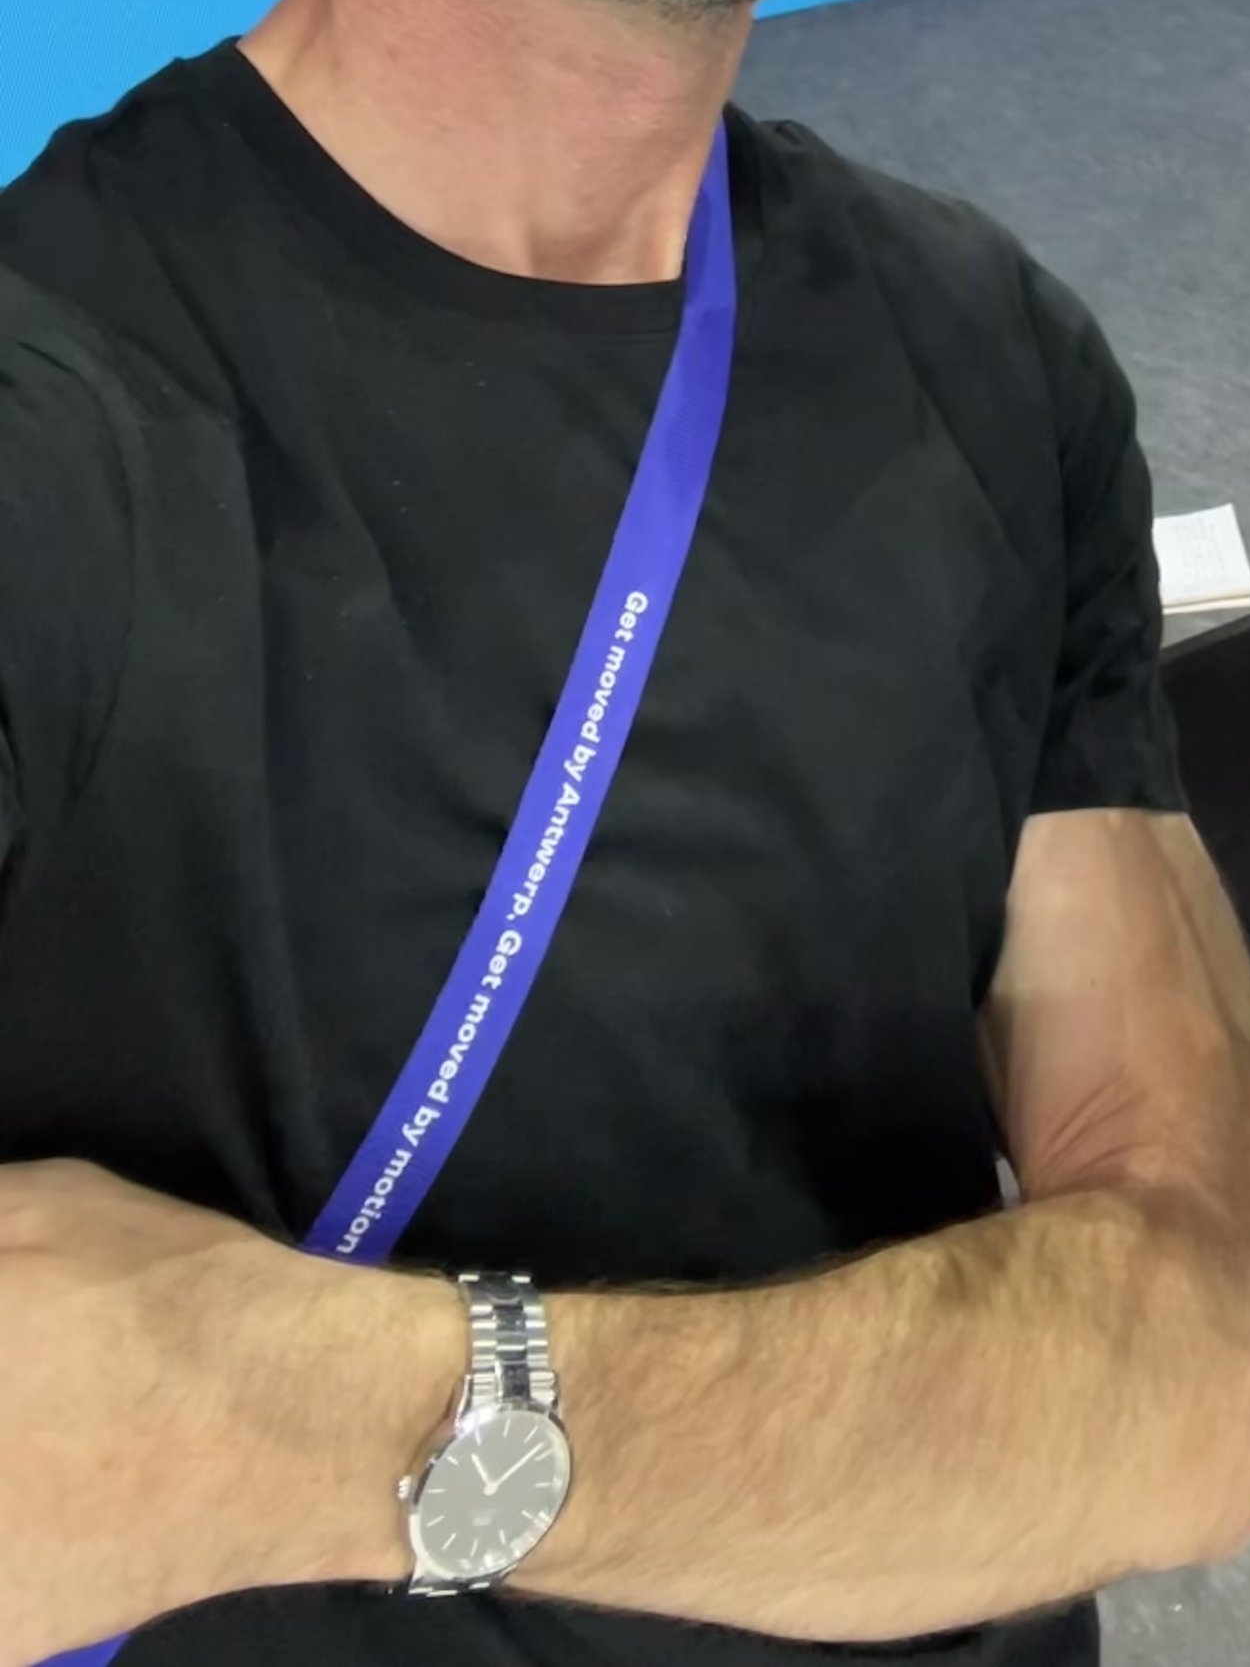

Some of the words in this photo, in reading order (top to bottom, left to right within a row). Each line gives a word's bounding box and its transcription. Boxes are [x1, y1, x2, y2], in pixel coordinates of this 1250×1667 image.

[613, 590, 649, 643] Get
[579, 644, 627, 744] moved
[563, 743, 598, 783] by
[505, 781, 581, 921] Antwerp.
[481, 929, 523, 990] Get
[427, 993, 491, 1104] moved
[402, 1105, 441, 1147] by
[336, 1148, 413, 1255] motion
